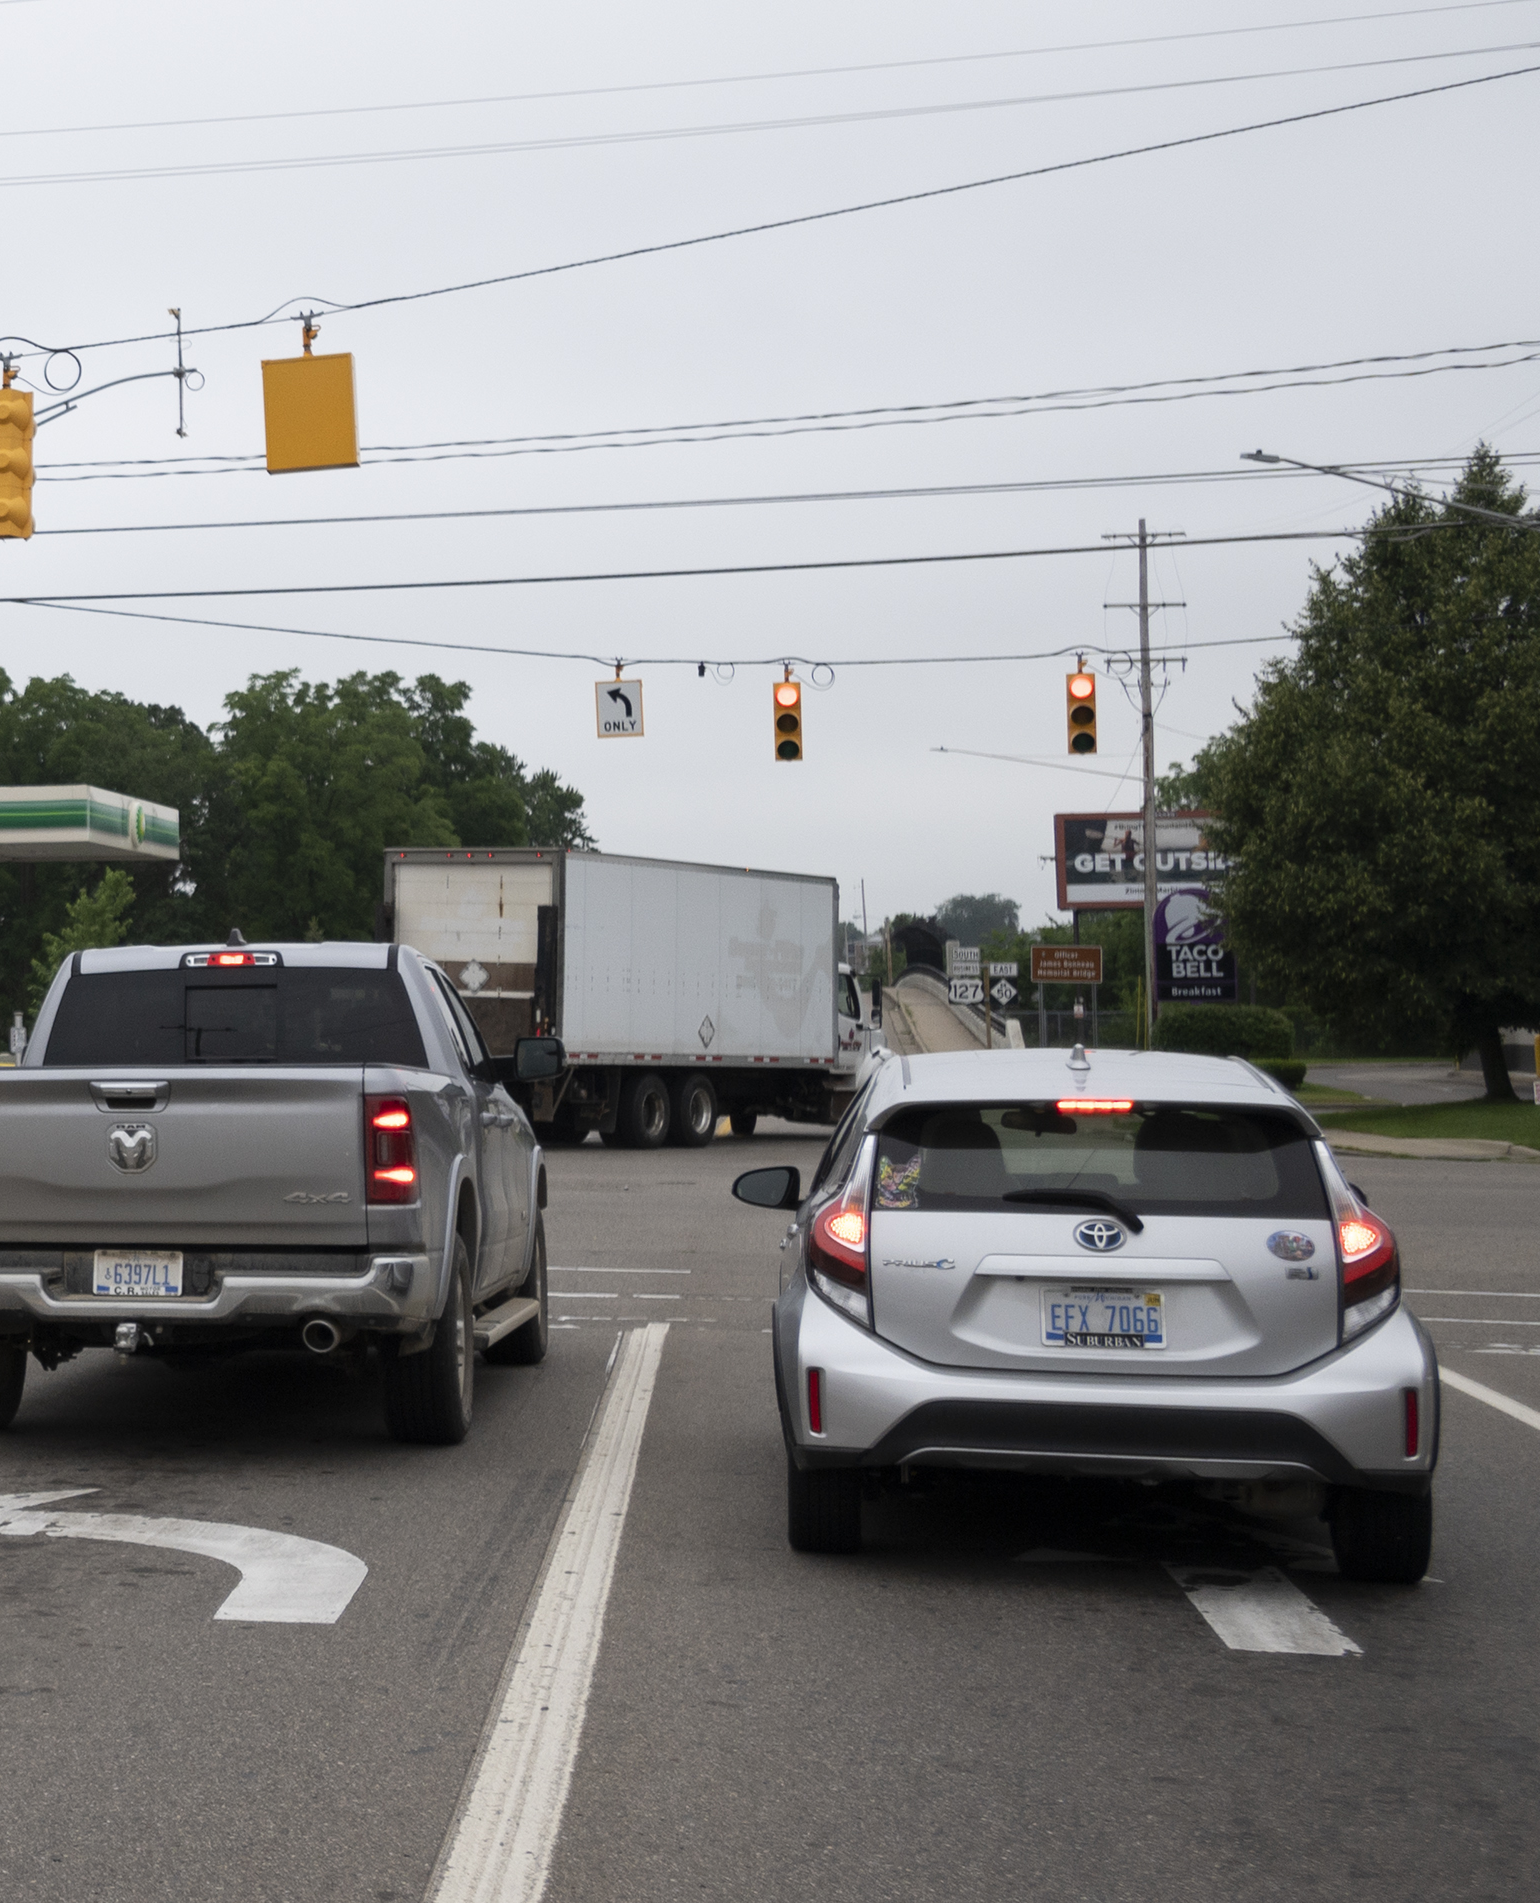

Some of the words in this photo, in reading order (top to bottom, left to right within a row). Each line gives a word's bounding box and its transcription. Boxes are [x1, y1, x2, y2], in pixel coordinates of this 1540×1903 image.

[604, 720, 636, 732] ONLY
[1074, 853, 1126, 873] GET
[953, 950, 978, 960] SOUTH
[1054, 951, 1078, 960] Officer
[1166, 944, 1224, 961] TACO
[953, 965, 978, 973] BUSINESS
[993, 964, 1013, 975] EAST
[1040, 960, 1061, 969] James
[1063, 960, 1095, 969] Bonneau
[1172, 961, 1224, 978] BELL
[1037, 968, 1070, 977] Memorial
[1072, 969, 1096, 979] Bridge
[953, 984, 979, 999] 127
[996, 988, 1012, 999] 50
[1171, 986, 1222, 997] Breakfast
[114, 1263, 170, 1286] 6397L1
[1051, 1304, 1089, 1332] EFX
[1104, 1305, 1159, 1334] 7066
